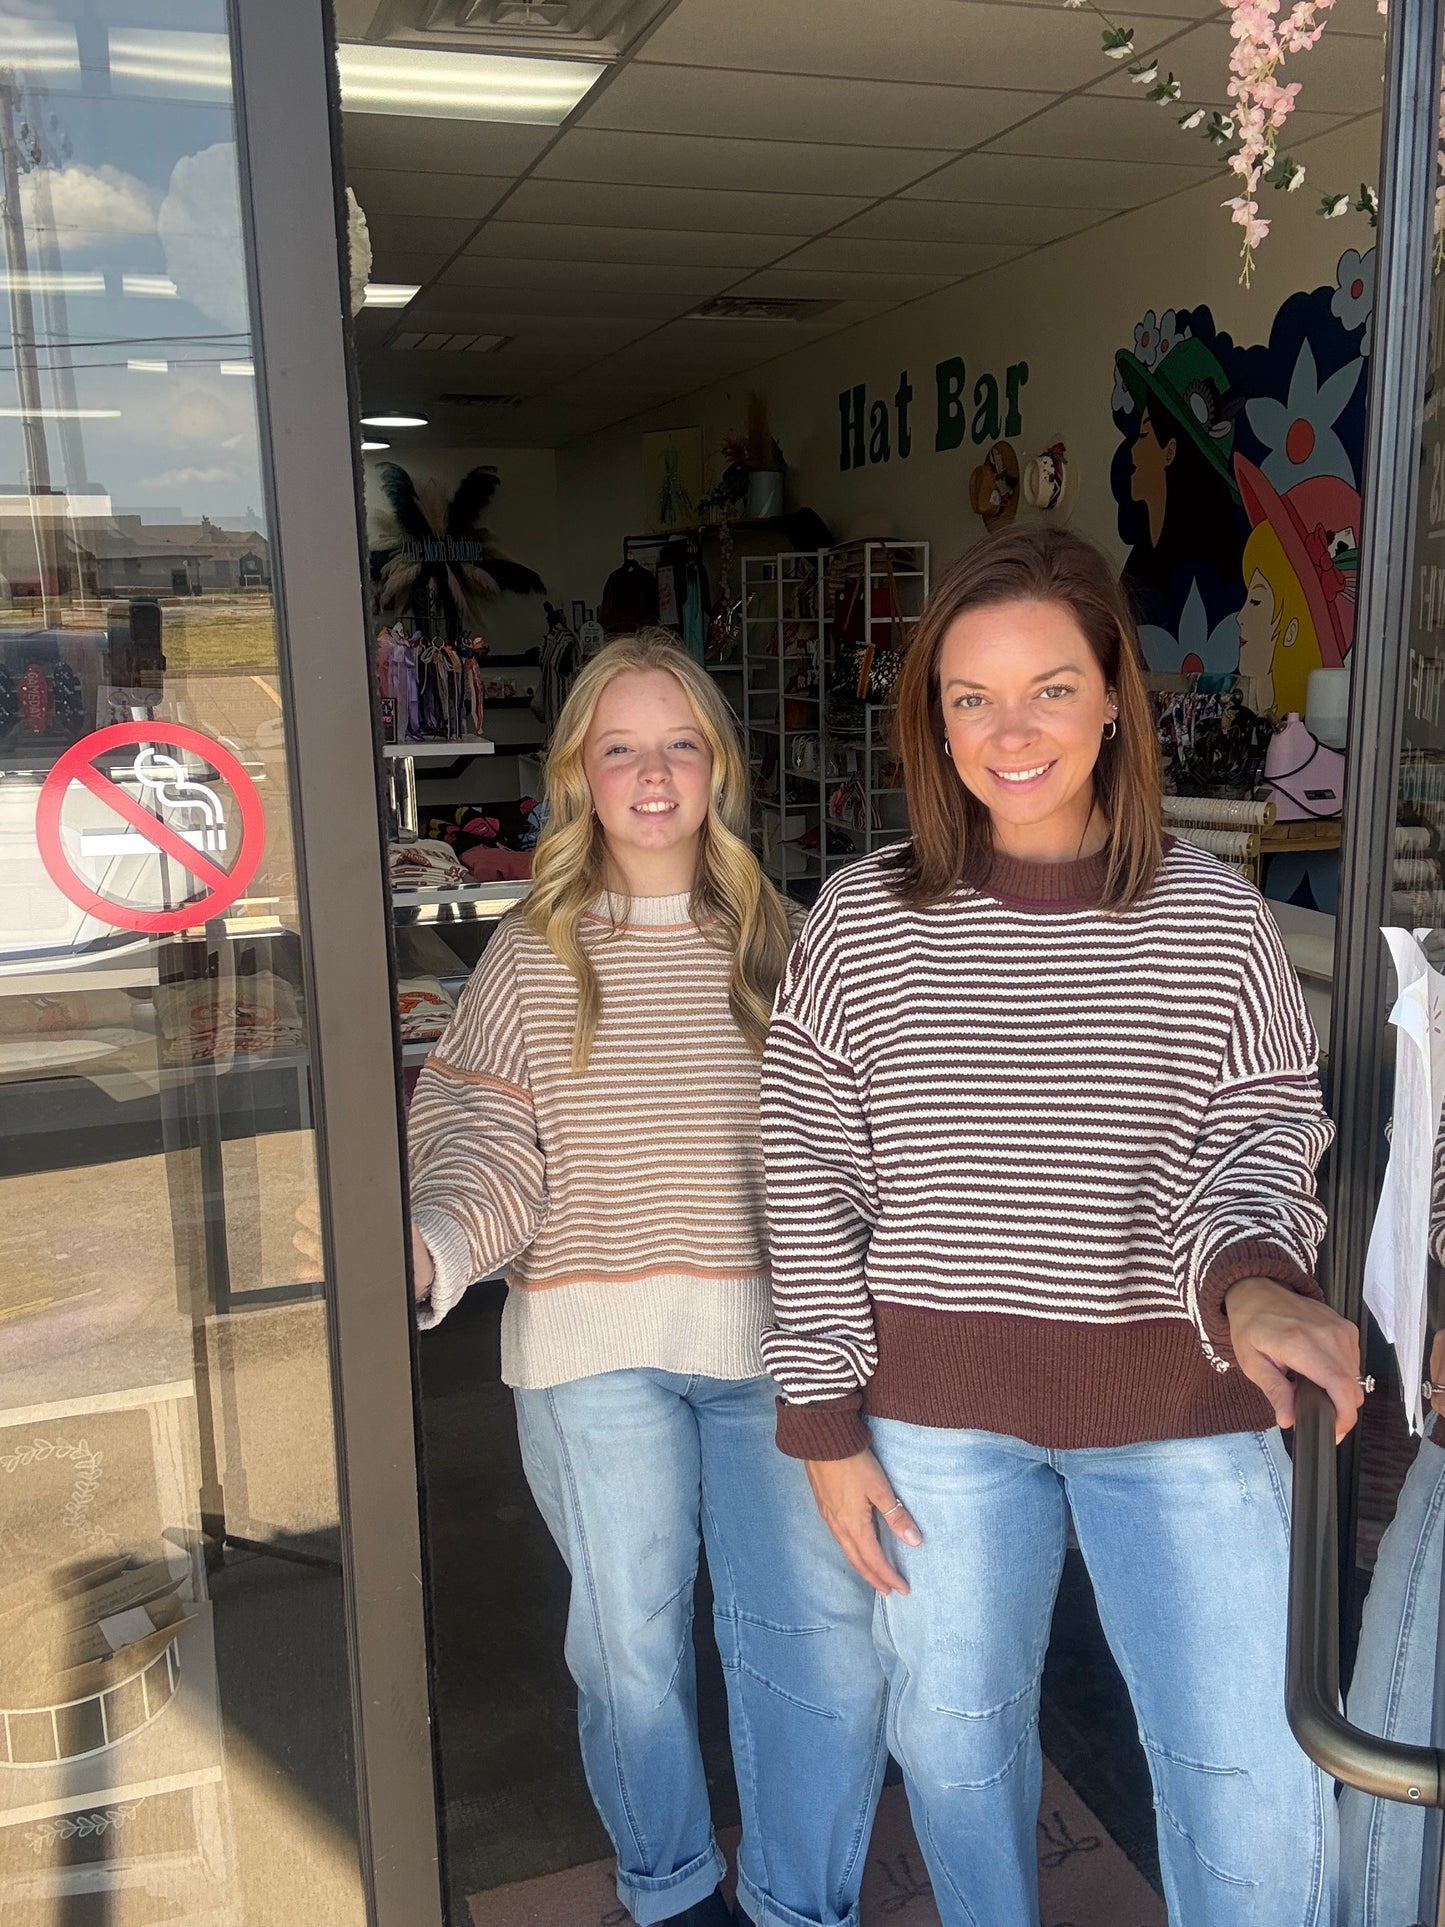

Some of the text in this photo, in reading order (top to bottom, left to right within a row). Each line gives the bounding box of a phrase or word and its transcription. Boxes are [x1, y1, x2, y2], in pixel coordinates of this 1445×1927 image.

[838, 356, 1029, 472] Hat Bar
[447, 535, 483, 565] Boutique
[27, 672, 41, 720] GAMEDAY
